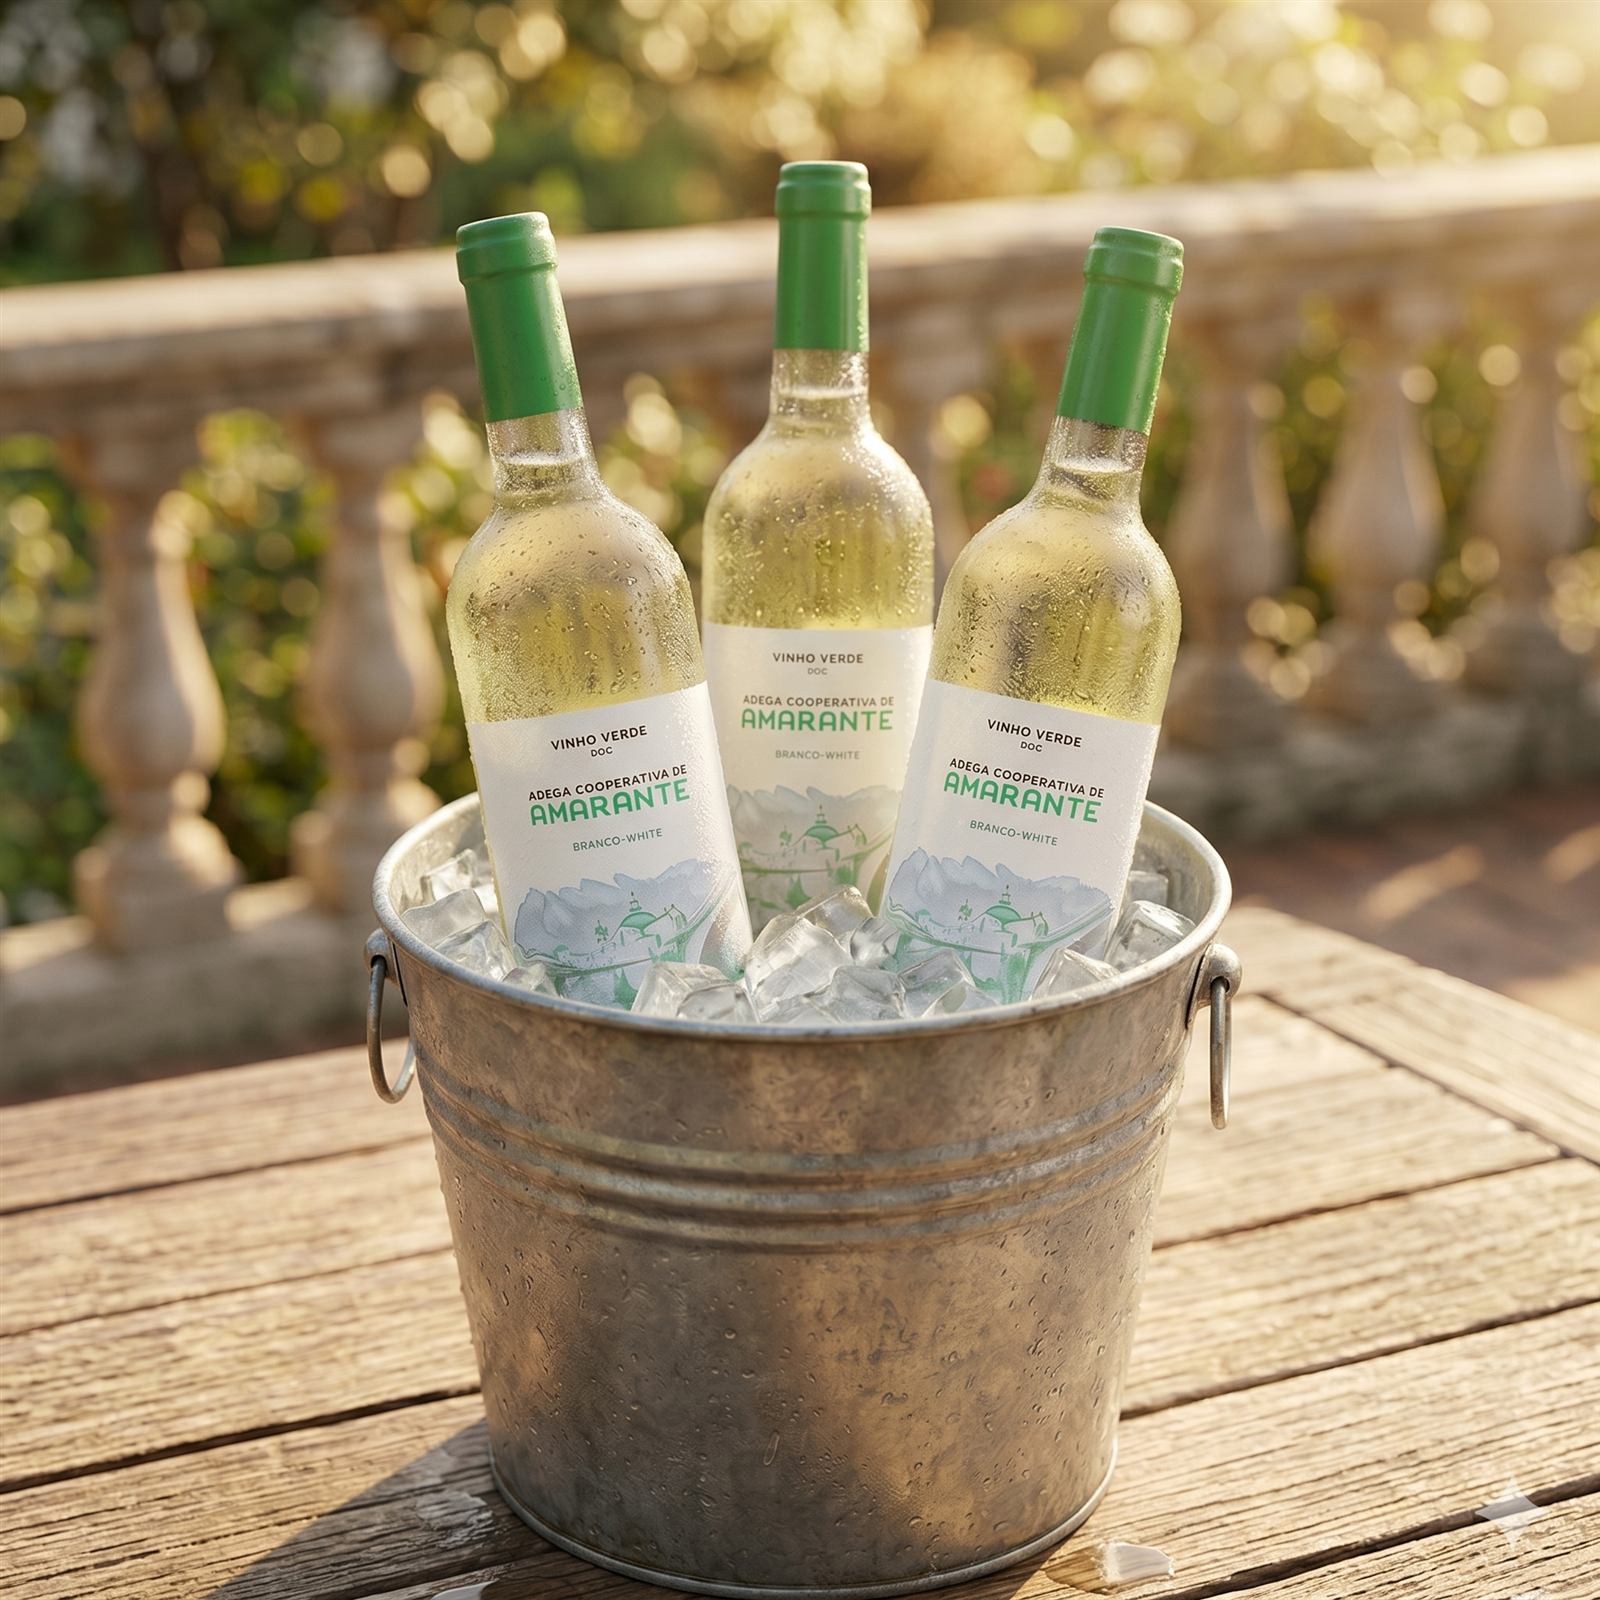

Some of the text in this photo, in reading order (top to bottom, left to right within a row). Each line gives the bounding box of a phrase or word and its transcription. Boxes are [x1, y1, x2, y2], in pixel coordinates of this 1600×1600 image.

[772, 652, 864, 664] VINHO VERDE
[807, 667, 828, 675] DOC
[743, 694, 894, 707] ADEGA COOPERATIVA DE
[741, 708, 893, 731] AMARANTE
[550, 725, 648, 751] VINHO VERDE
[987, 718, 1083, 748] VINHO VERDE
[590, 746, 614, 757] DOC
[775, 750, 860, 760] BRANCO-WHITE
[1020, 741, 1043, 753] DOC
[528, 764, 687, 802] ADEGA COOPERATIVA DE
[949, 758, 1105, 798] ADEGA COOPERATIVA DE
[530, 778, 690, 826] AMARANTE
[943, 771, 1102, 823] AMARANTE
[572, 828, 663, 852] BRANCO-WHITE
[969, 819, 1059, 846] BRANCO-WHITE
